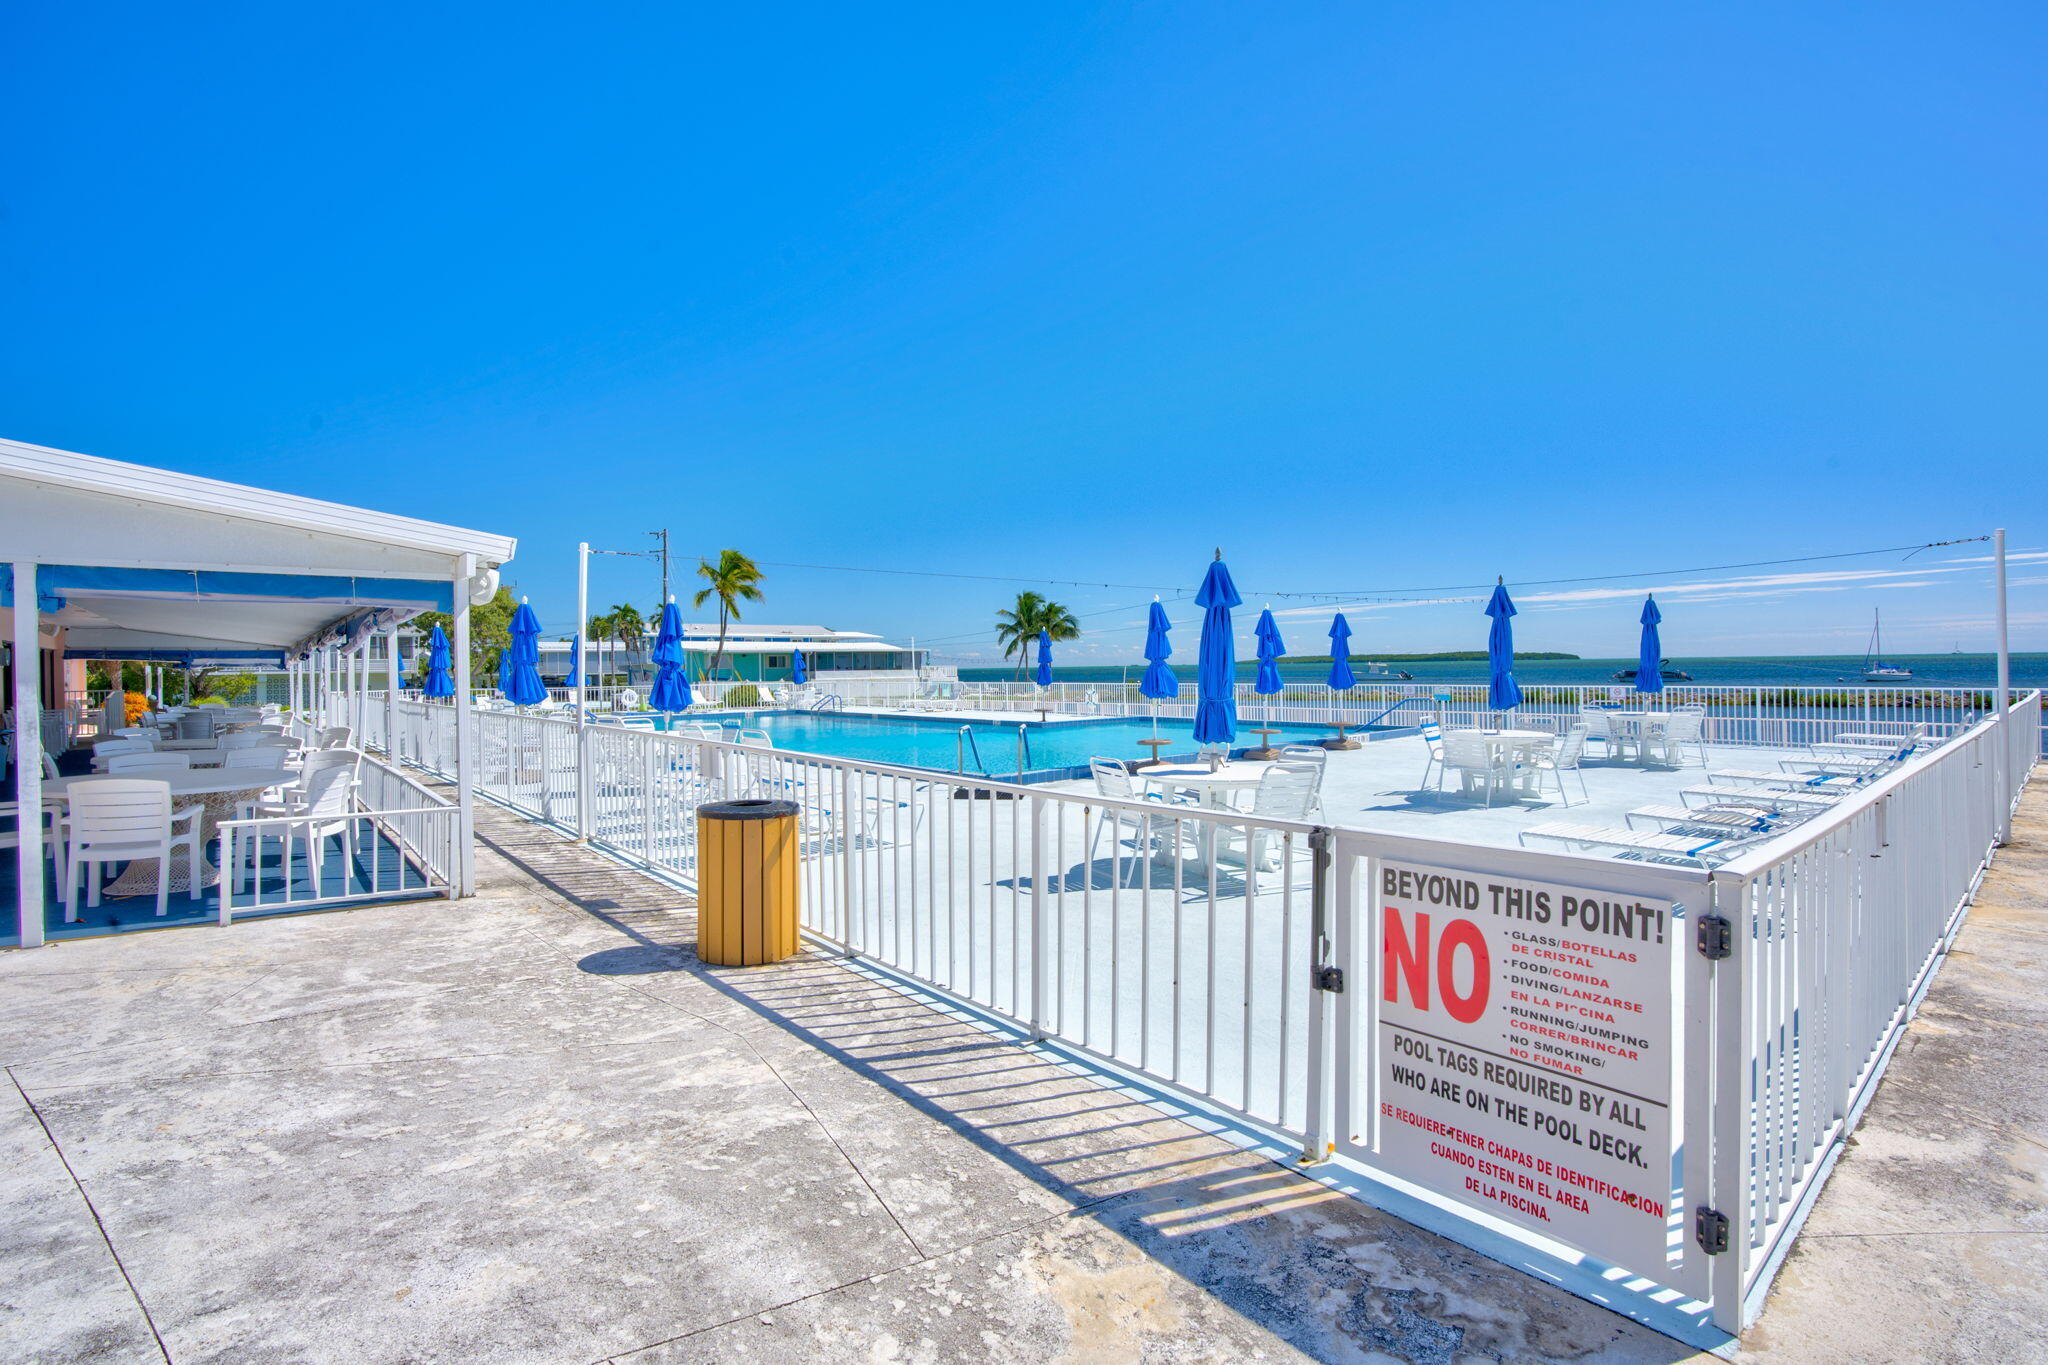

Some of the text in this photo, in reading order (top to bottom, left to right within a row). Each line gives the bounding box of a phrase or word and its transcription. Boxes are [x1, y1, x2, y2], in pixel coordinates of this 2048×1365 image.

[1384, 868, 1664, 944] BEYOND THIS POINT!
[1384, 906, 1490, 1024] NO
[1512, 931, 1637, 963] GLASS/BOTELLAS
[1512, 944, 1594, 968] DE CRISTAL
[1511, 960, 1610, 988] FOOD/COMIDA
[1511, 975, 1643, 1013] DIVING/LANZARSE
[1510, 1006, 1649, 1049] RUNNING/JUMPING
[1511, 991, 1615, 1023] EN LA PICINA
[1510, 1019, 1638, 1061] CORRER/BRINCAR
[1510, 1035, 1605, 1068] NO SMOKING/
[1510, 1047, 1583, 1074] NO FUMAR
[1394, 1034, 1646, 1130] POOL TAGS REQUIRED BY ALL
[1392, 1064, 1648, 1170] WHO ARE ON THE POOL DECK.
[1381, 1102, 1664, 1218] SE REQUIERE TENER CHAPAS DE IDENTIFICACION
[1430, 1142, 1589, 1214] CUANDO ESTEN EN EL AREA
[1465, 1176, 1551, 1222] DE LA PISCINA.
